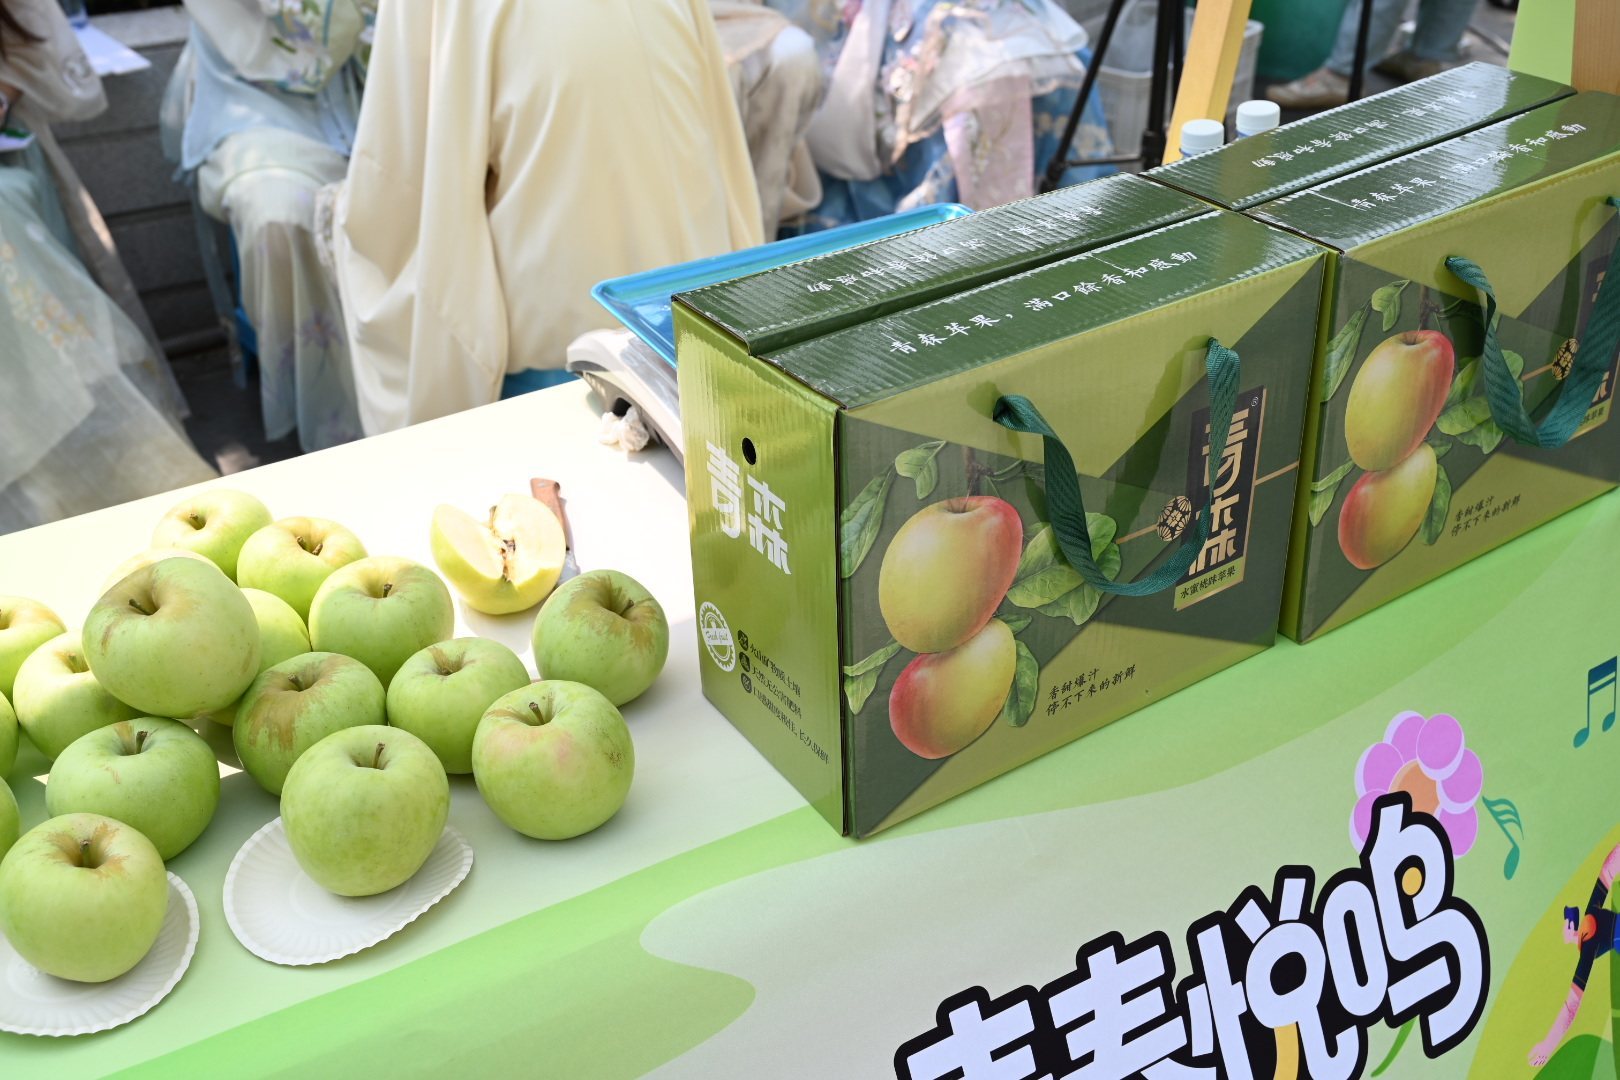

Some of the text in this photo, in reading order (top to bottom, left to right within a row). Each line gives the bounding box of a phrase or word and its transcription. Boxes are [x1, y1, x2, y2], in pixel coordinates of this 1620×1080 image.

[706, 440, 792, 575] 青森
[1048, 668, 1100, 700] 香甜爆汁
